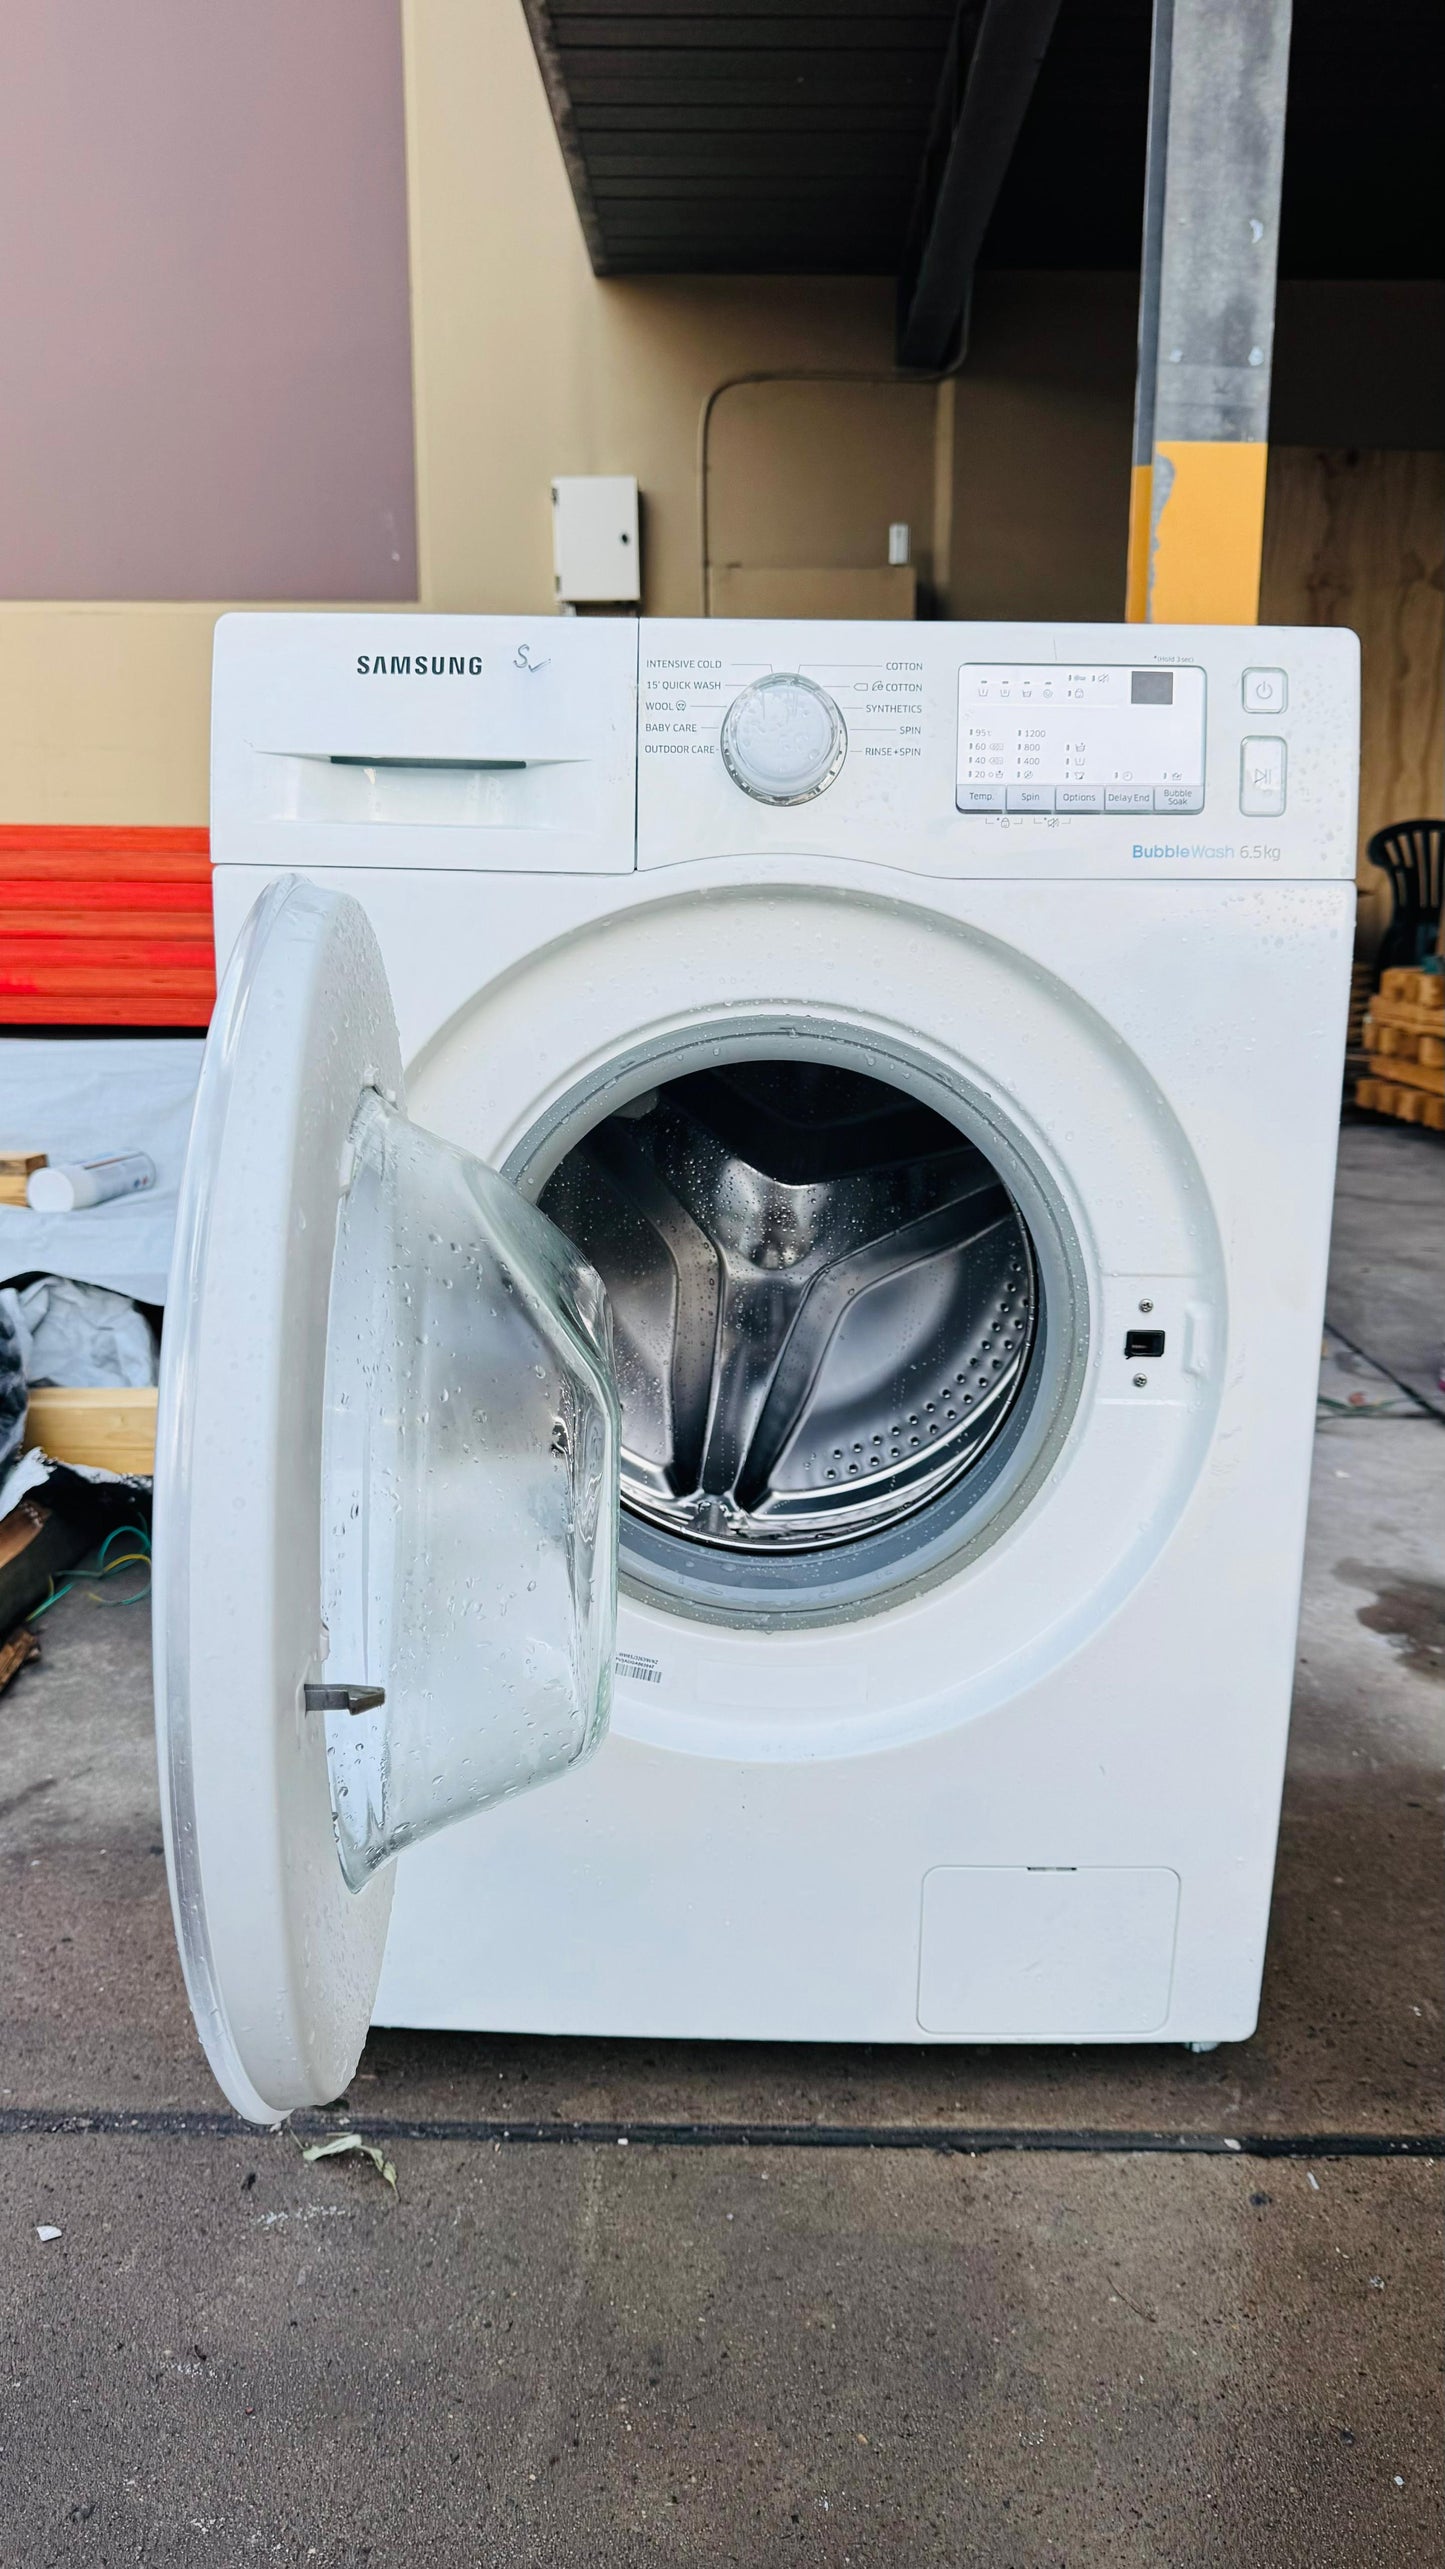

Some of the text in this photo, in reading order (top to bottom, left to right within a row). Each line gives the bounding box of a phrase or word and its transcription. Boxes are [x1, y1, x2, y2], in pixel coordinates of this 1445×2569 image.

[357, 655, 483, 675] SAMSUNG
[646, 660, 722, 669] INTENSIVE COLD
[886, 662, 923, 671] COTTON
[662, 681, 692, 690] QUICK
[693, 681, 721, 690] WASH
[885, 683, 923, 692] COTTON
[645, 702, 674, 711] WOOL
[866, 704, 922, 714] SYNTHETICS
[645, 723, 697, 732] BABY CARE
[899, 726, 922, 735] SPIN
[1025, 729, 1046, 738] 1200
[644, 745, 715, 754] OUTDOOR CARE
[975, 742, 986, 751] 60
[1024, 743, 1040, 752] 800
[974, 756, 986, 765] 40
[1023, 757, 1040, 766] 400
[974, 770, 986, 779] 20
[1021, 792, 1040, 802] Spin
[1063, 793, 1096, 802] Options
[1164, 789, 1193, 797] Bubble
[1108, 793, 1150, 803] Delay End
[1168, 798, 1188, 806] Soak
